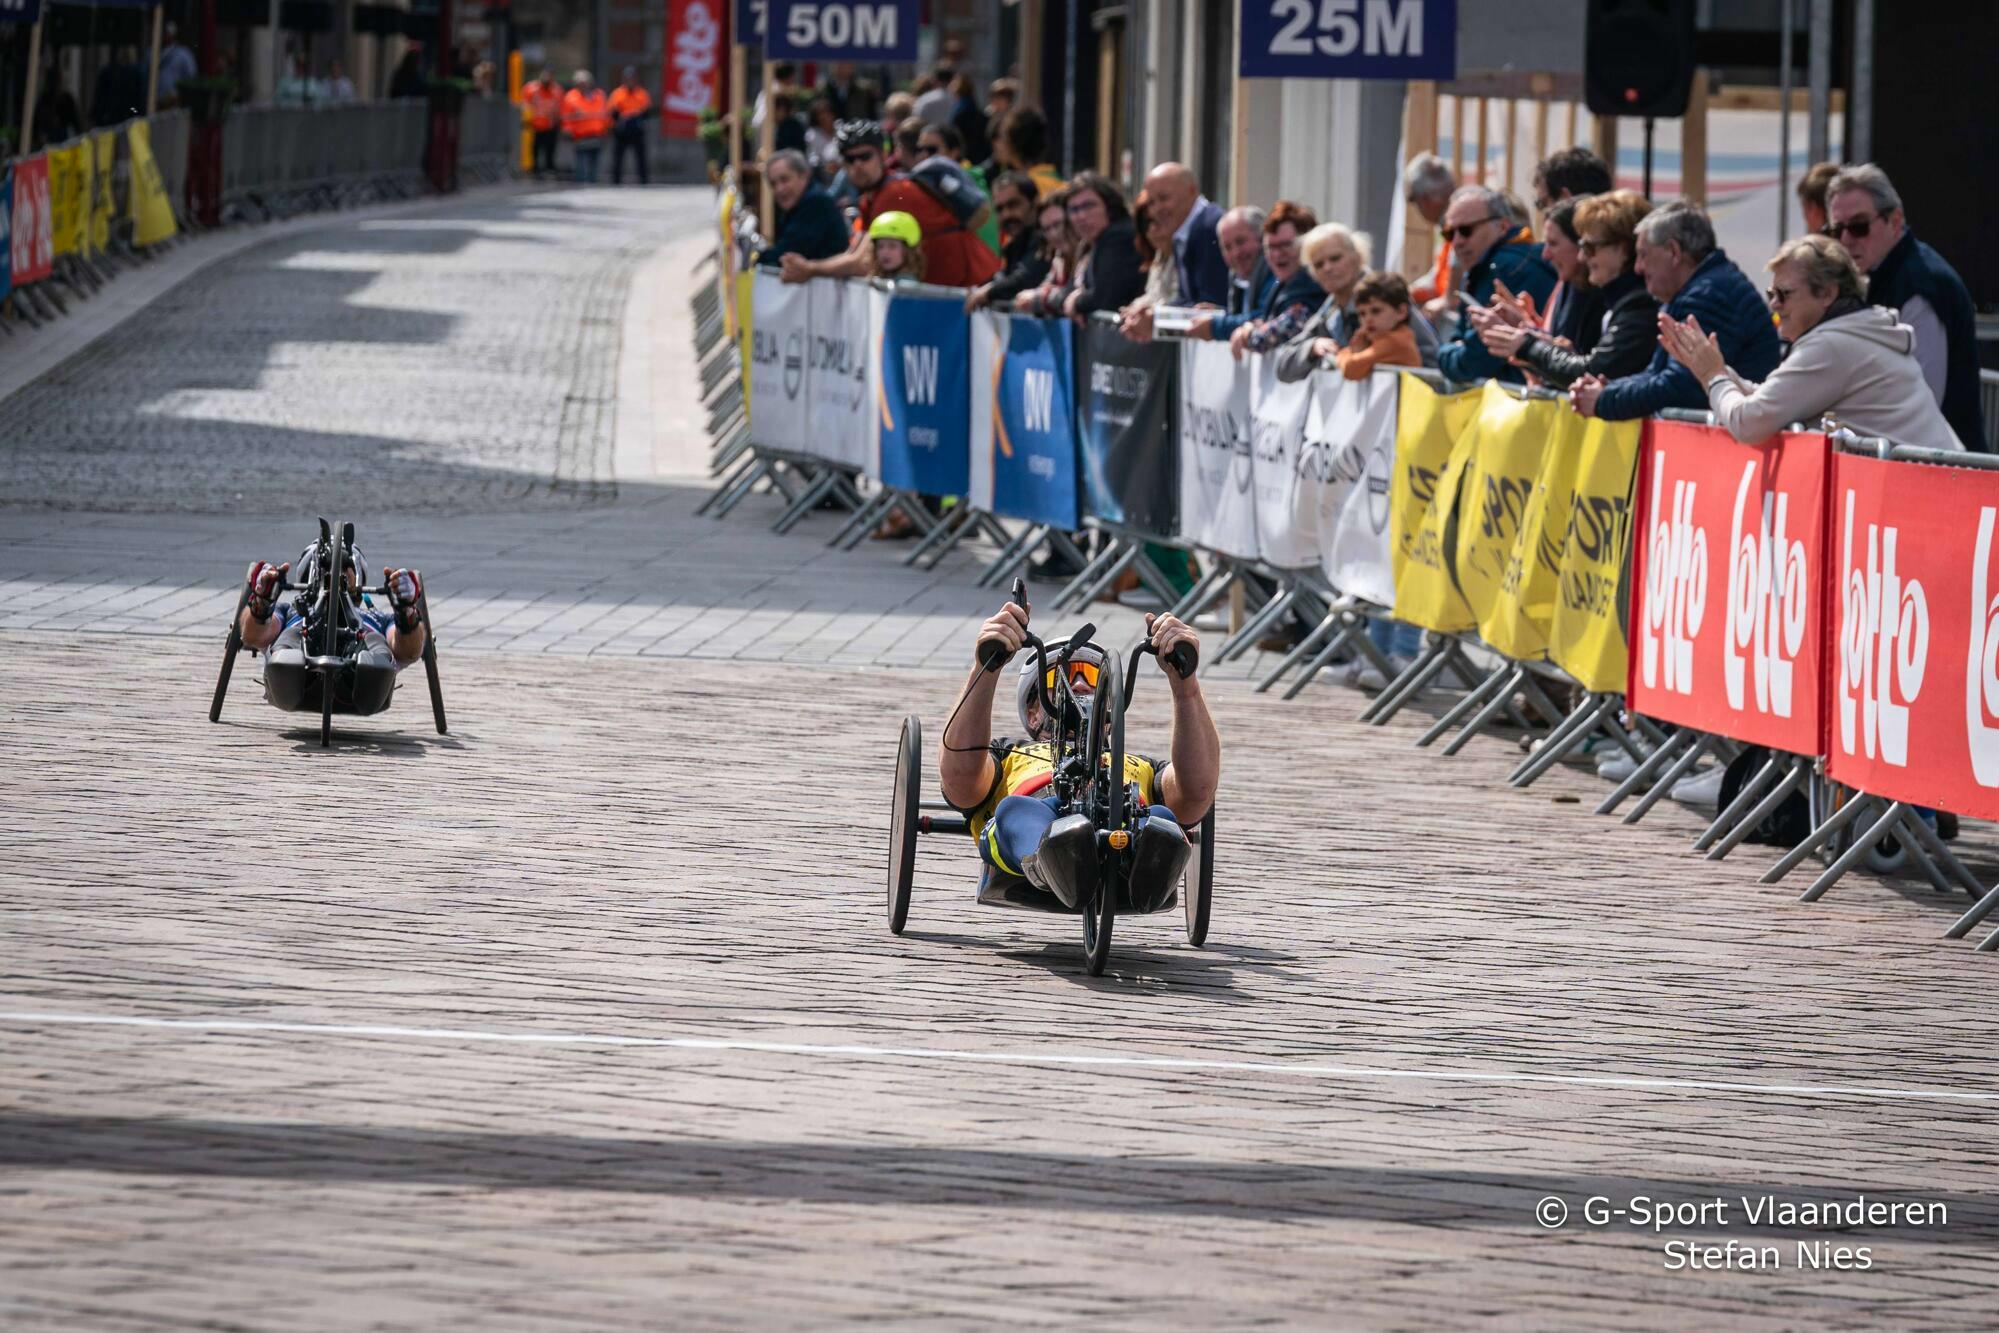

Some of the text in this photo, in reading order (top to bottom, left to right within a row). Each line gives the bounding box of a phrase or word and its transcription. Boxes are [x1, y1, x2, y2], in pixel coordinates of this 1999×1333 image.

[666, 3, 719, 114] lotto
[787, 4, 898, 48] 50M
[1268, 0, 1424, 56] 25M
[1643, 450, 1708, 695] lotto
[1724, 460, 1807, 718] lotto
[1840, 489, 1929, 767] lotto
